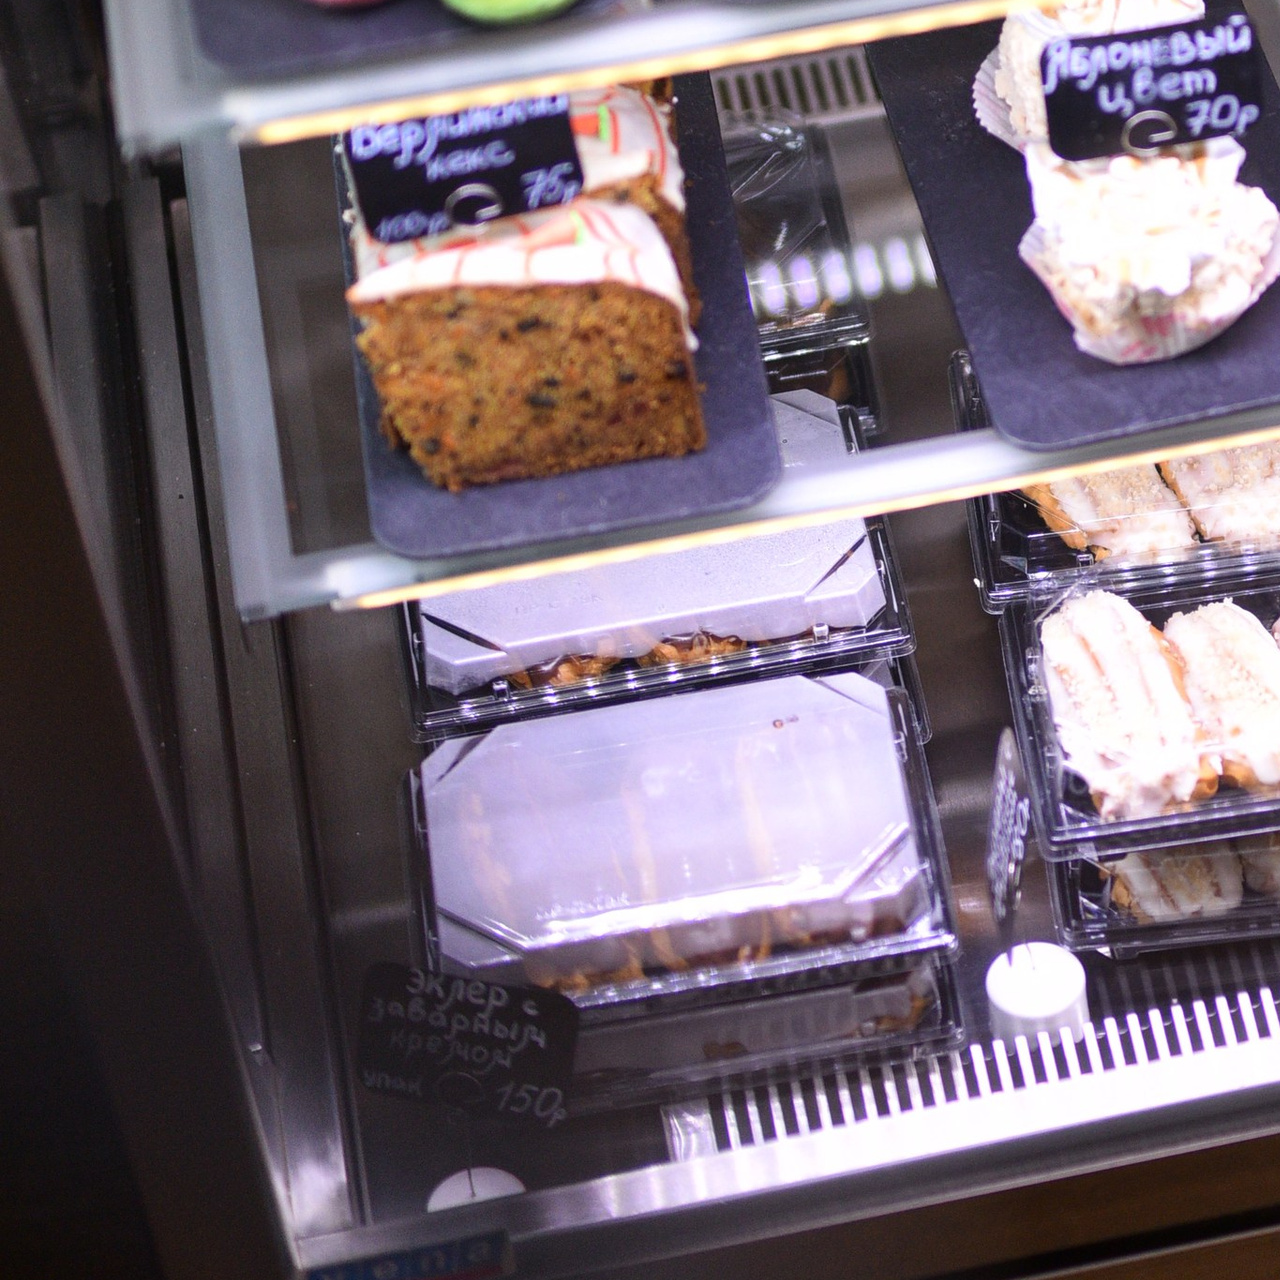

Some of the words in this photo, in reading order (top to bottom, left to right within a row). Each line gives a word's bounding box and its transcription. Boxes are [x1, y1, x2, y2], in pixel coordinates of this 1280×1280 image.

[1044, 14, 1251, 95] Яблоневый
[1098, 67, 1217, 118] цвет
[1186, 94, 1260, 136] 70р
[426, 139, 516, 181] кекс
[520, 162, 582, 209] 75р
[369, 998, 546, 1052] заварным
[523, 1001, 538, 1015] с
[389, 1029, 515, 1074] кремом
[496, 1083, 567, 1128] 150р
